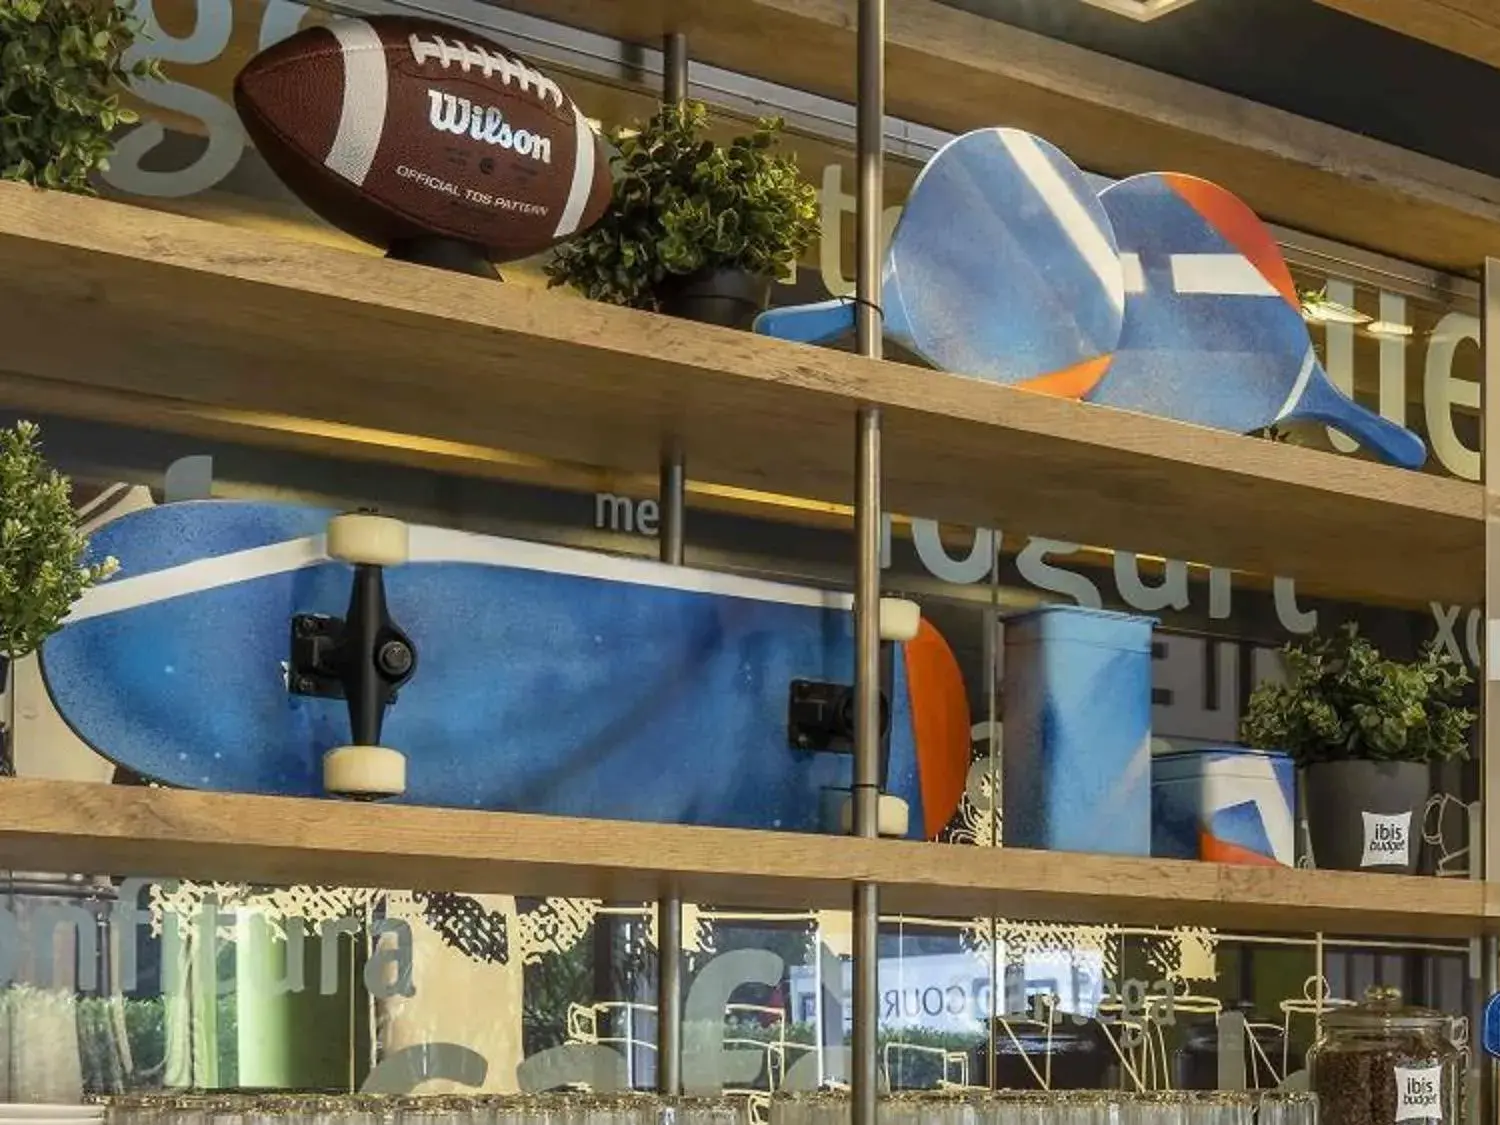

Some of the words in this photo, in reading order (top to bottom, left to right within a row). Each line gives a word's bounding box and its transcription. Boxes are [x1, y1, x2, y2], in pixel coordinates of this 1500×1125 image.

[428, 89, 550, 163] Wilson
[395, 165, 461, 197] OFFICIAL
[464, 189, 492, 205] TDS
[494, 197, 549, 216] PATTERN
[1375, 823, 1402, 841] ibis
[1407, 1077, 1433, 1095] ibis
